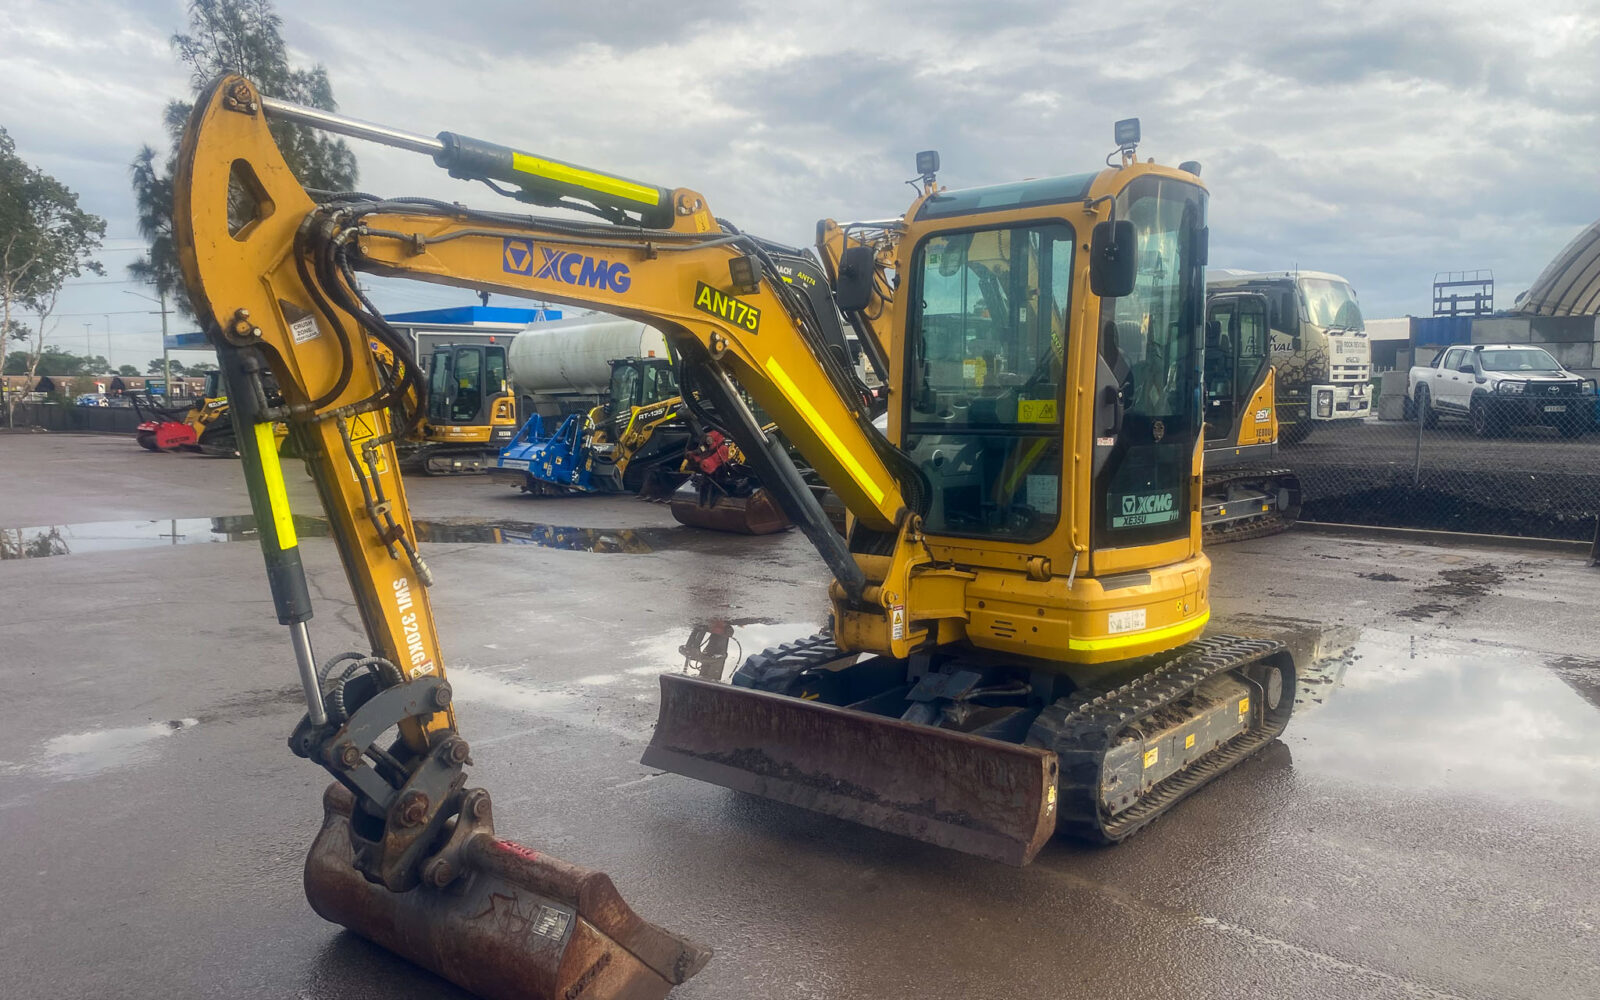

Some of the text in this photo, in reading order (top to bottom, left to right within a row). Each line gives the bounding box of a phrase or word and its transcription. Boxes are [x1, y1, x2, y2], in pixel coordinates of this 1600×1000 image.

[533, 246, 631, 293] XCMG
[293, 320, 312, 330] CRUSH
[696, 286, 757, 330] AN175
[1123, 515, 1147, 526] XE35U
[1136, 493, 1173, 514] XCMG
[393, 578, 413, 613] SWL
[401, 612, 426, 665] 320KG
